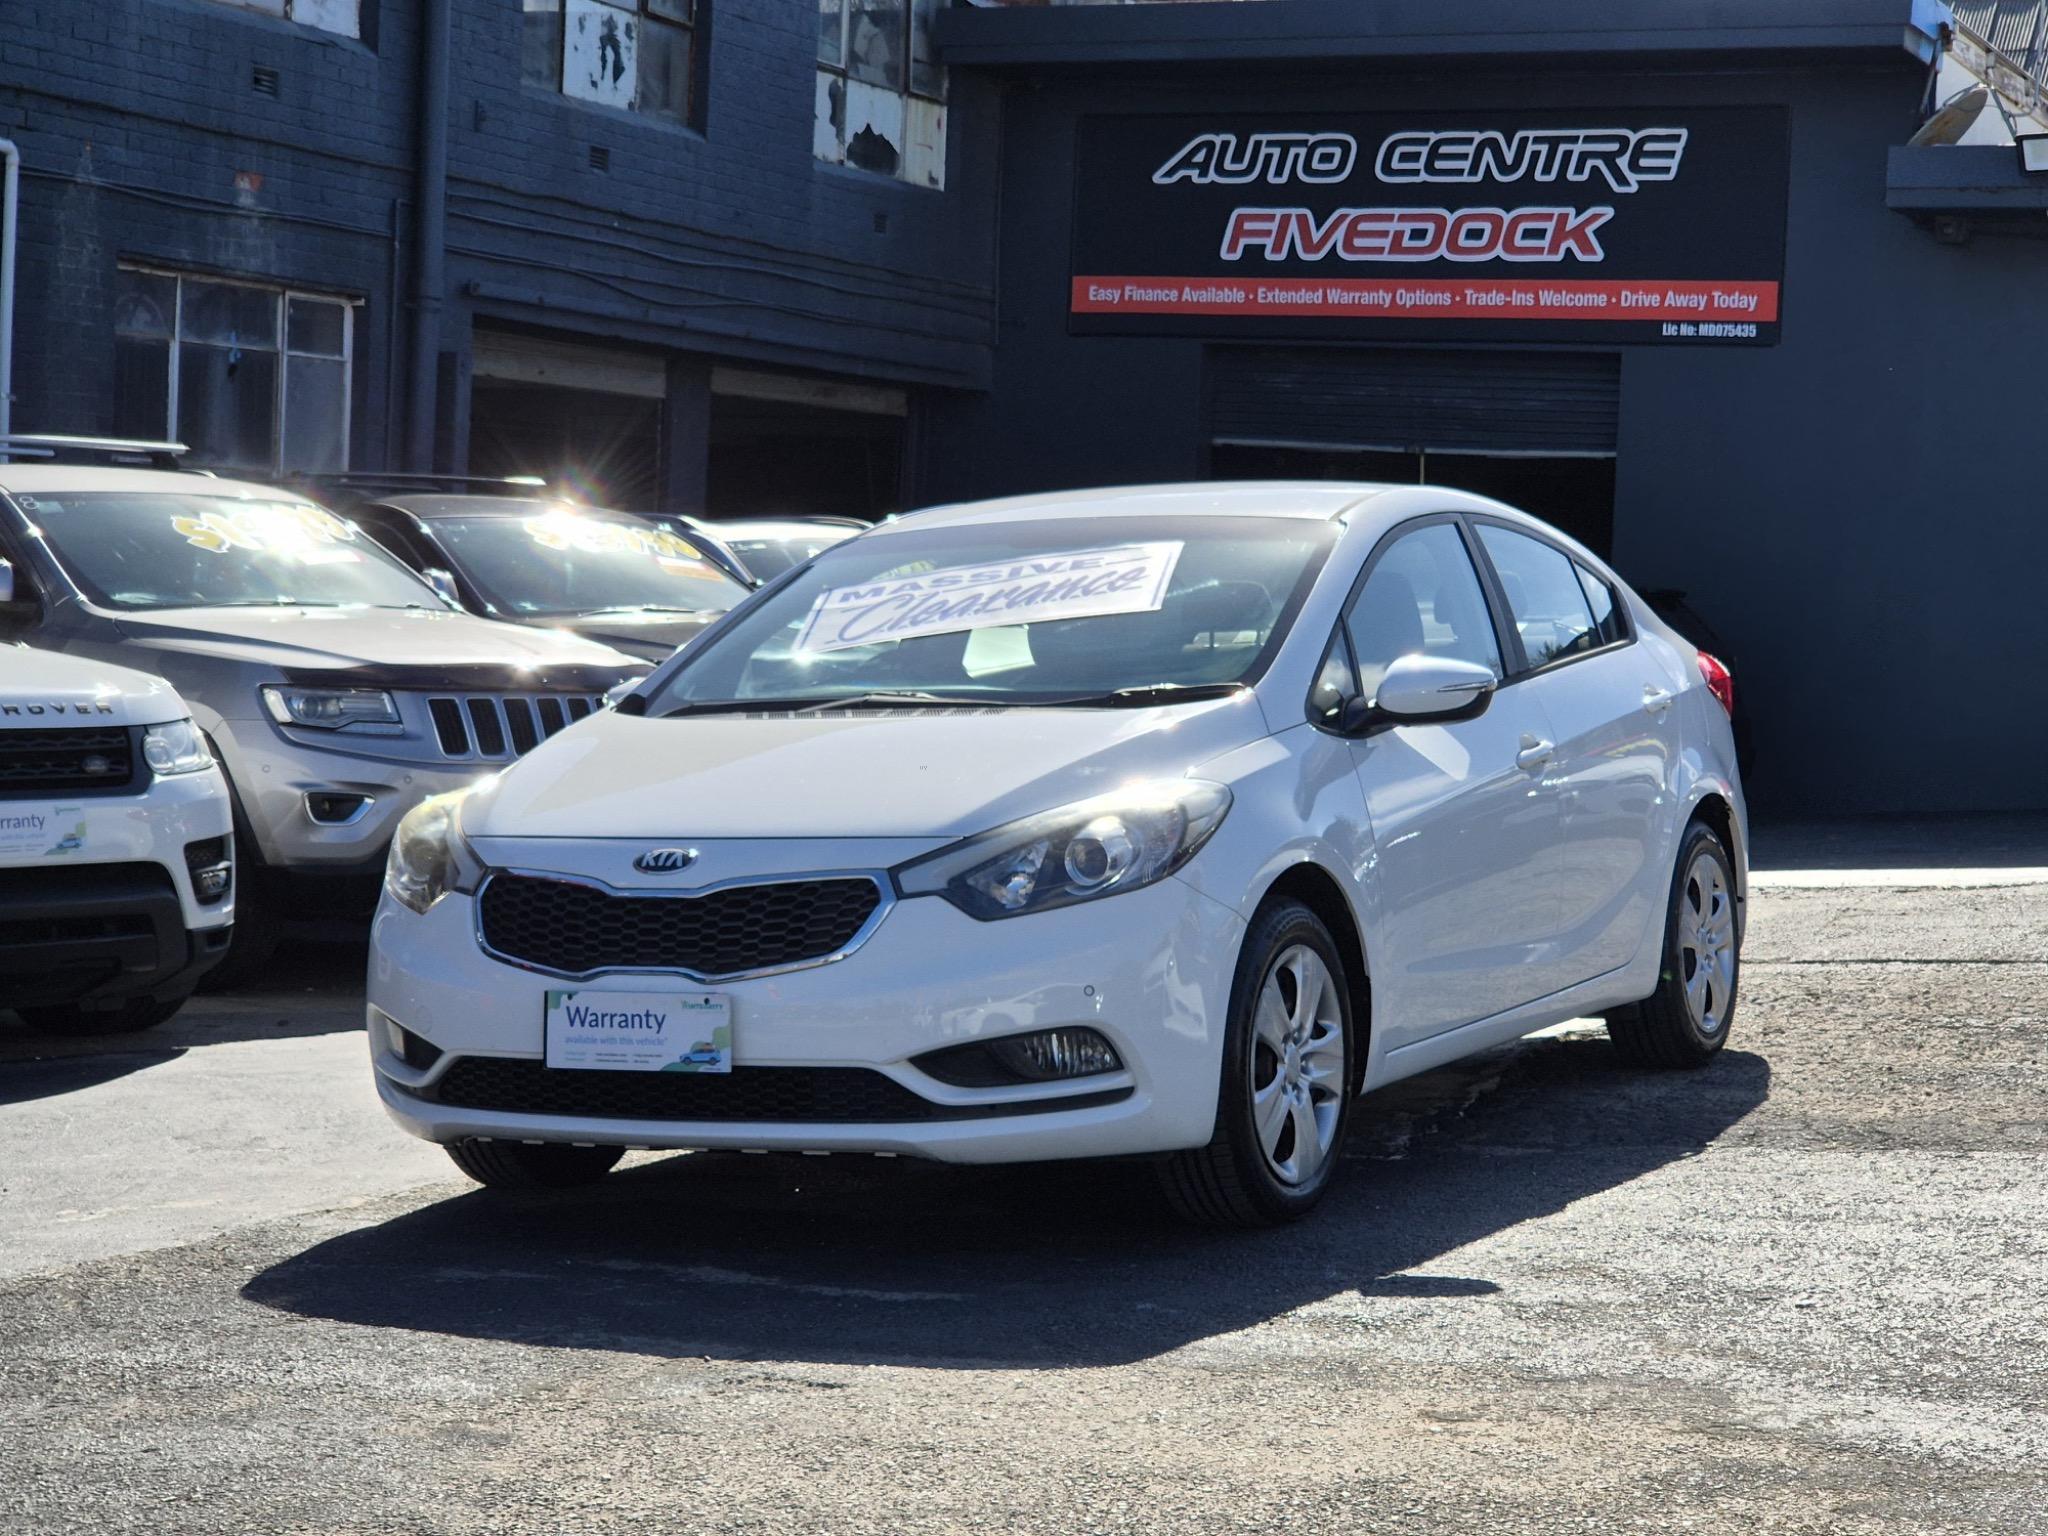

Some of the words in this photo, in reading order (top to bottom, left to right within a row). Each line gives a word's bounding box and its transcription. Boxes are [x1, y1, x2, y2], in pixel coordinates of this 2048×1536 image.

[1152, 132, 1357, 185] AUTO
[1374, 128, 1689, 194] CENTRE
[1220, 207, 1614, 262] FIVEDOCK
[1089, 286, 1121, 303] Easy
[1124, 286, 1178, 302] Finance
[1181, 287, 1245, 303] Available
[1257, 288, 1323, 304] Extended
[1326, 288, 1392, 308] Warranty
[1396, 289, 1451, 309] Options
[1465, 289, 1534, 306] Trade-Ins
[1538, 289, 1607, 307] Welcome
[1620, 290, 1660, 307] Drive
[1664, 291, 1707, 310] Away
[1711, 291, 1758, 311] Today
[1662, 322, 1678, 336] Lic
[839, 556, 1106, 602] MASSIVE
[837, 566, 1148, 641] Clearance
[1, 703, 114, 716] ROVER
[641, 852, 684, 867] KIA
[566, 1005, 666, 1034] Warranty
